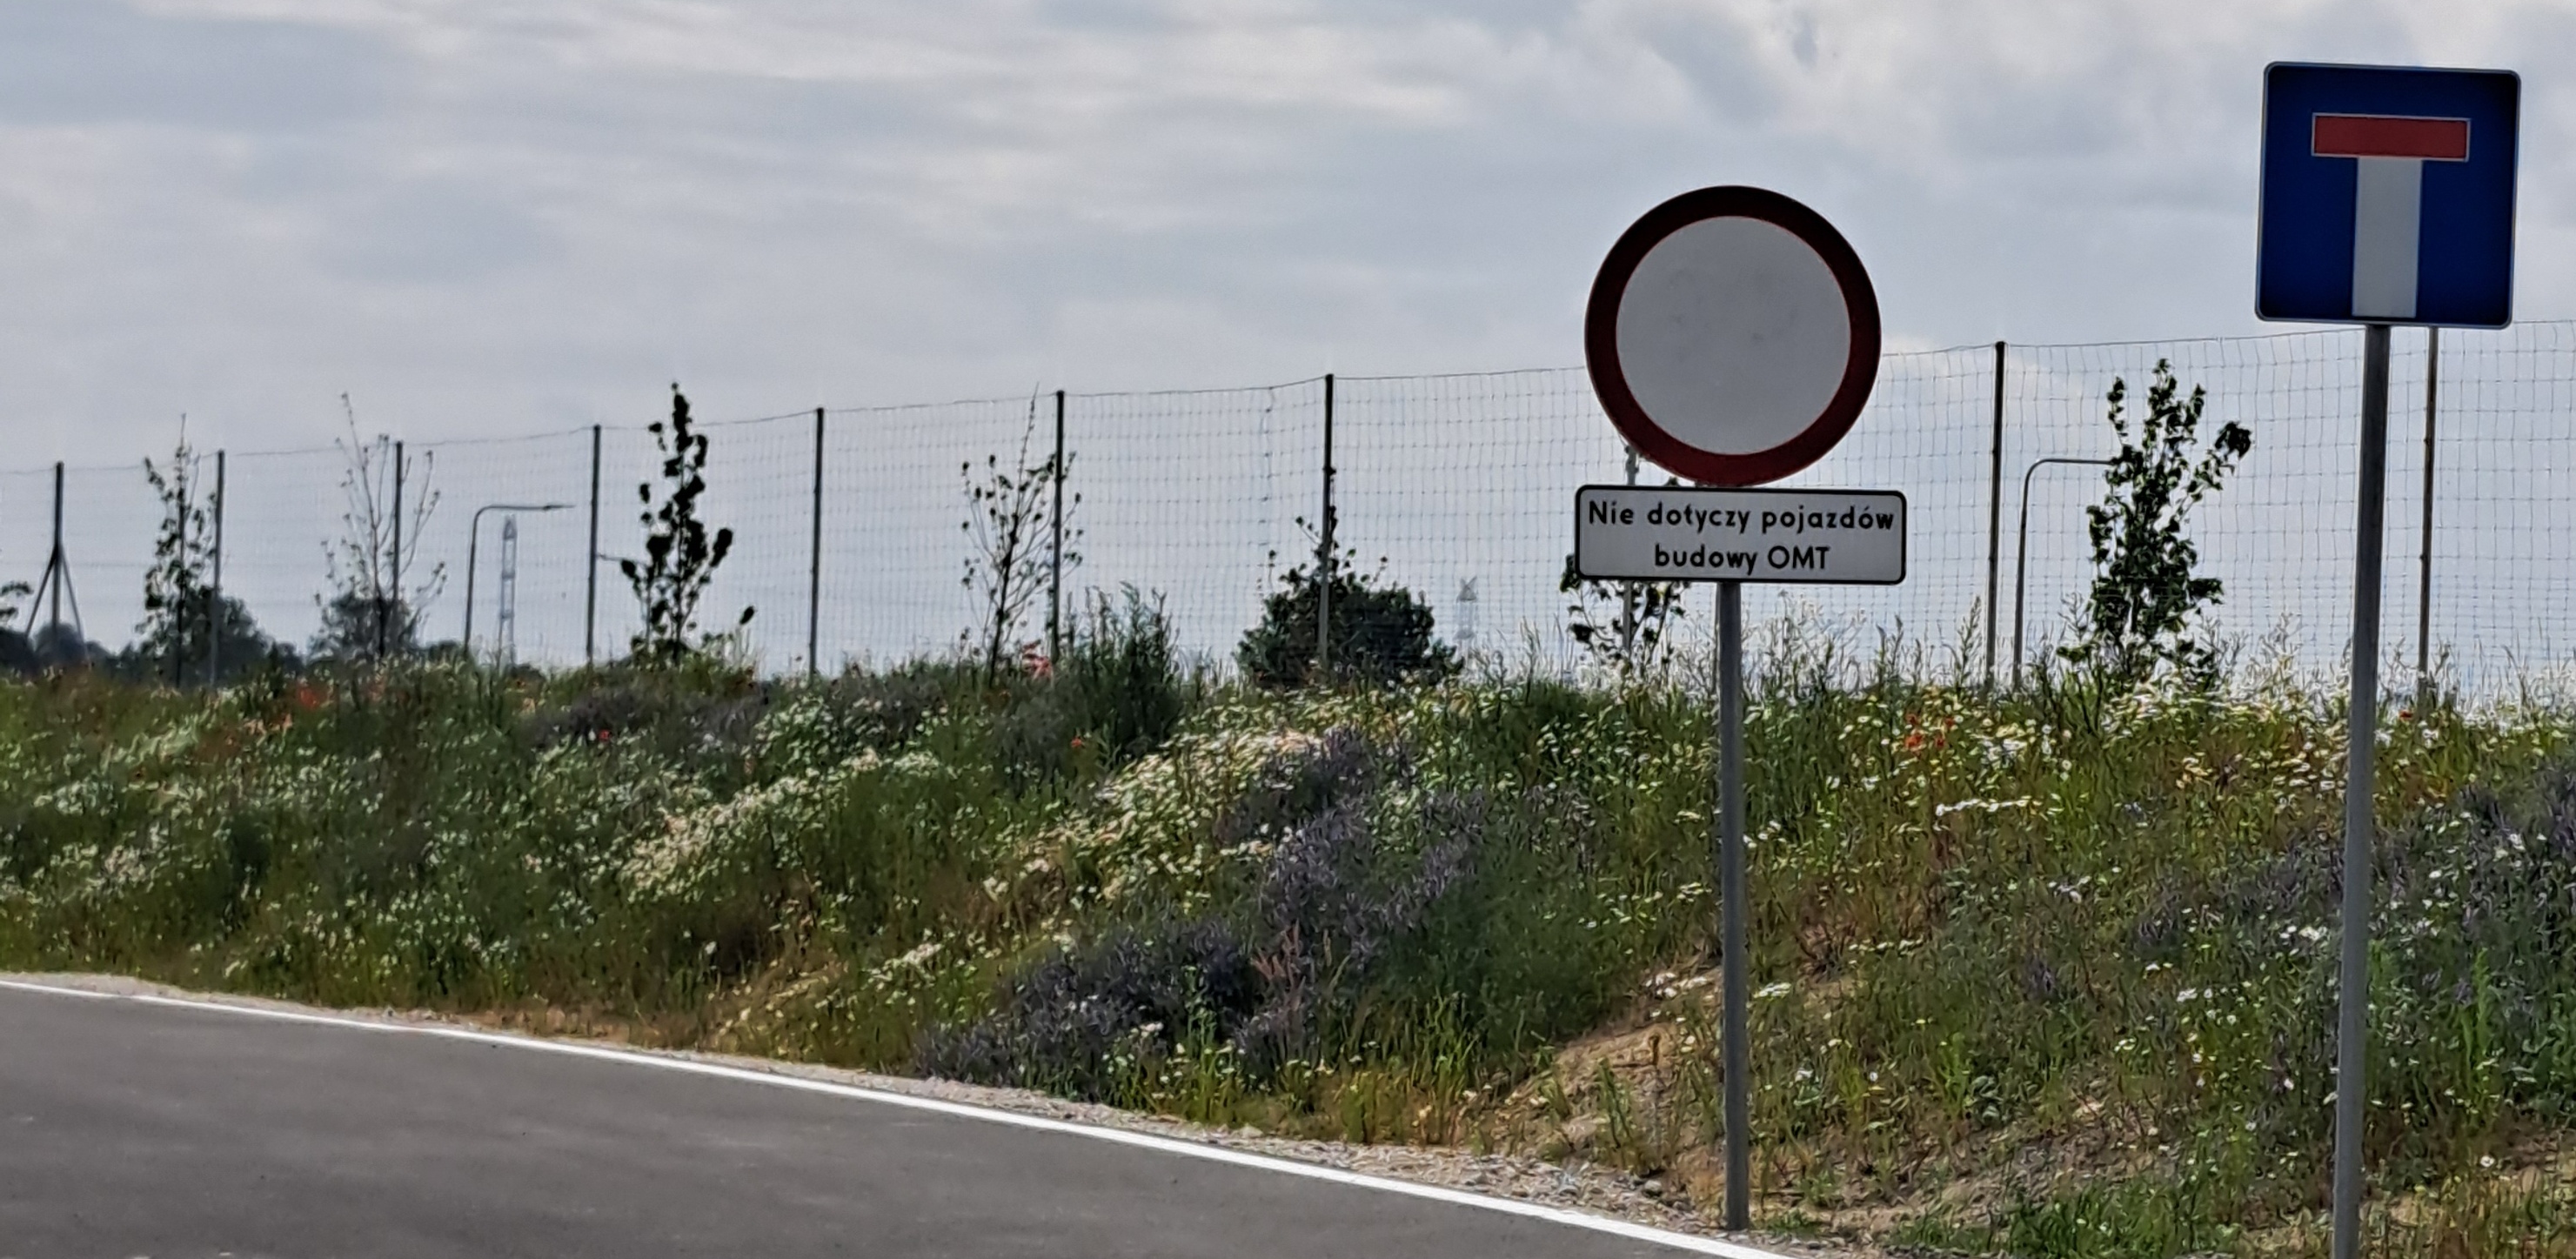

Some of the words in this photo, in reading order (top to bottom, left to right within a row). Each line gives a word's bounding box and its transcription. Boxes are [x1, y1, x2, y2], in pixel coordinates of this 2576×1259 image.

[1589, 499, 1635, 526] Nie
[1647, 500, 1751, 535] dotyczy
[1761, 503, 1895, 536] pojazdów
[1654, 542, 1758, 576] budowy
[1767, 545, 1830, 572] OMT
